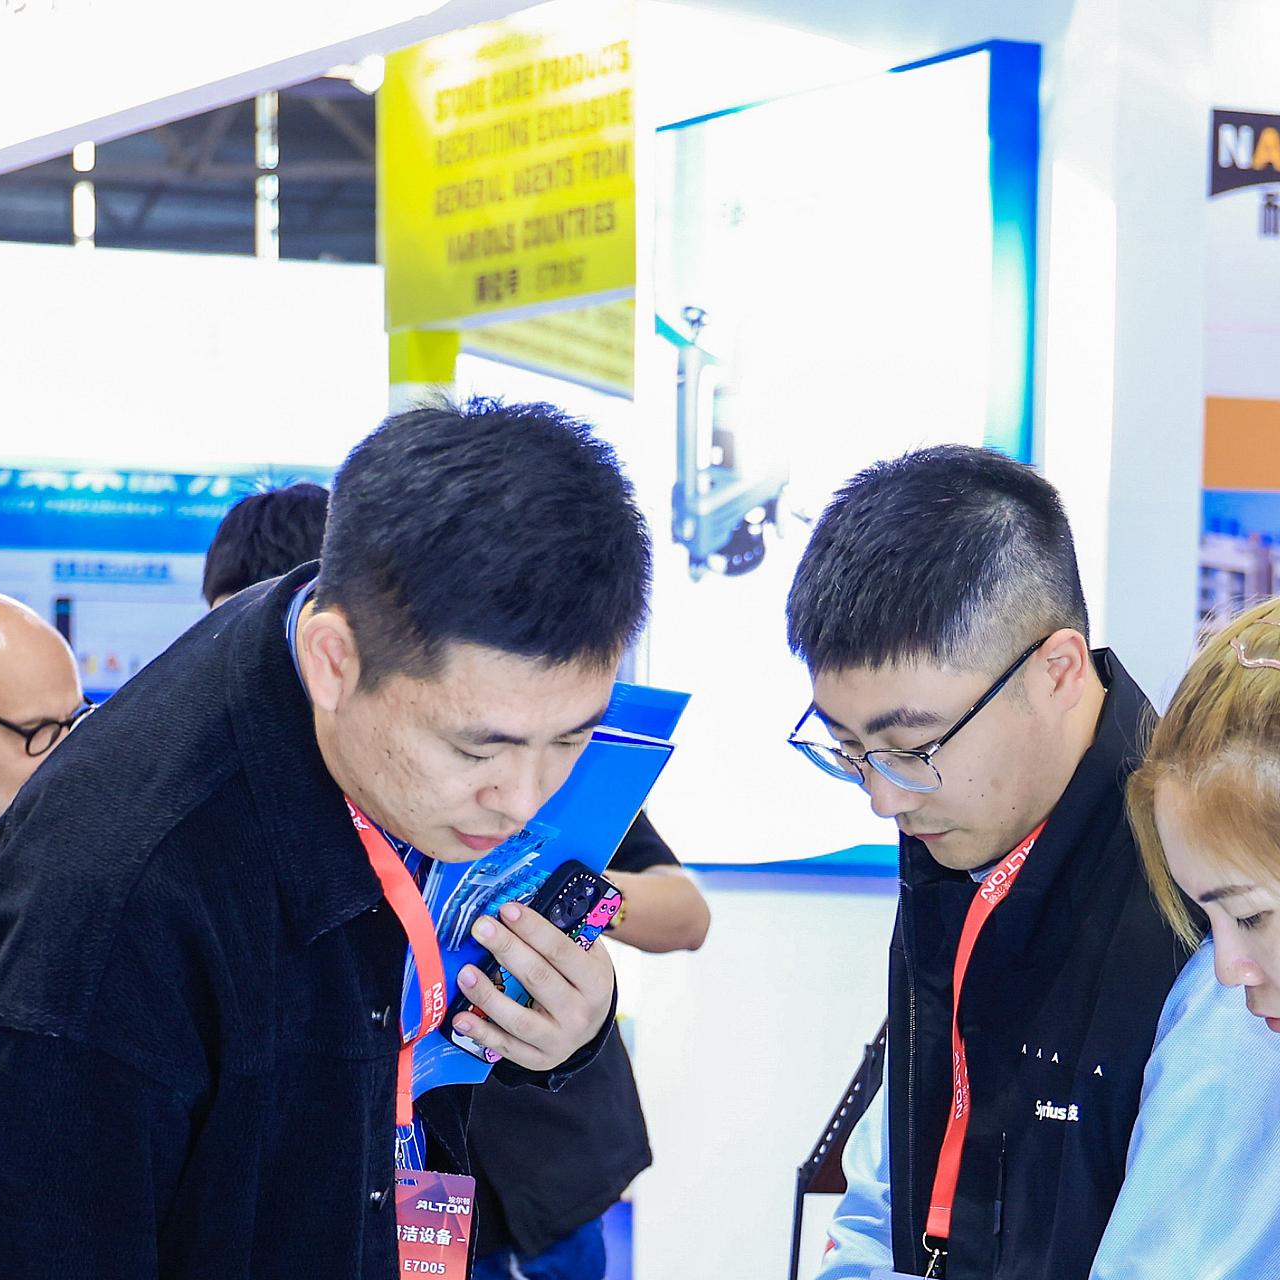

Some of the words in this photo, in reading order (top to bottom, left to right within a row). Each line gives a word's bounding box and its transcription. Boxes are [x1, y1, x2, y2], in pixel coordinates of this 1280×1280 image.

[953, 1051, 963, 1120] ALTON
[416, 1200, 470, 1214] ALTON
[404, 1260, 446, 1274] E7D05
